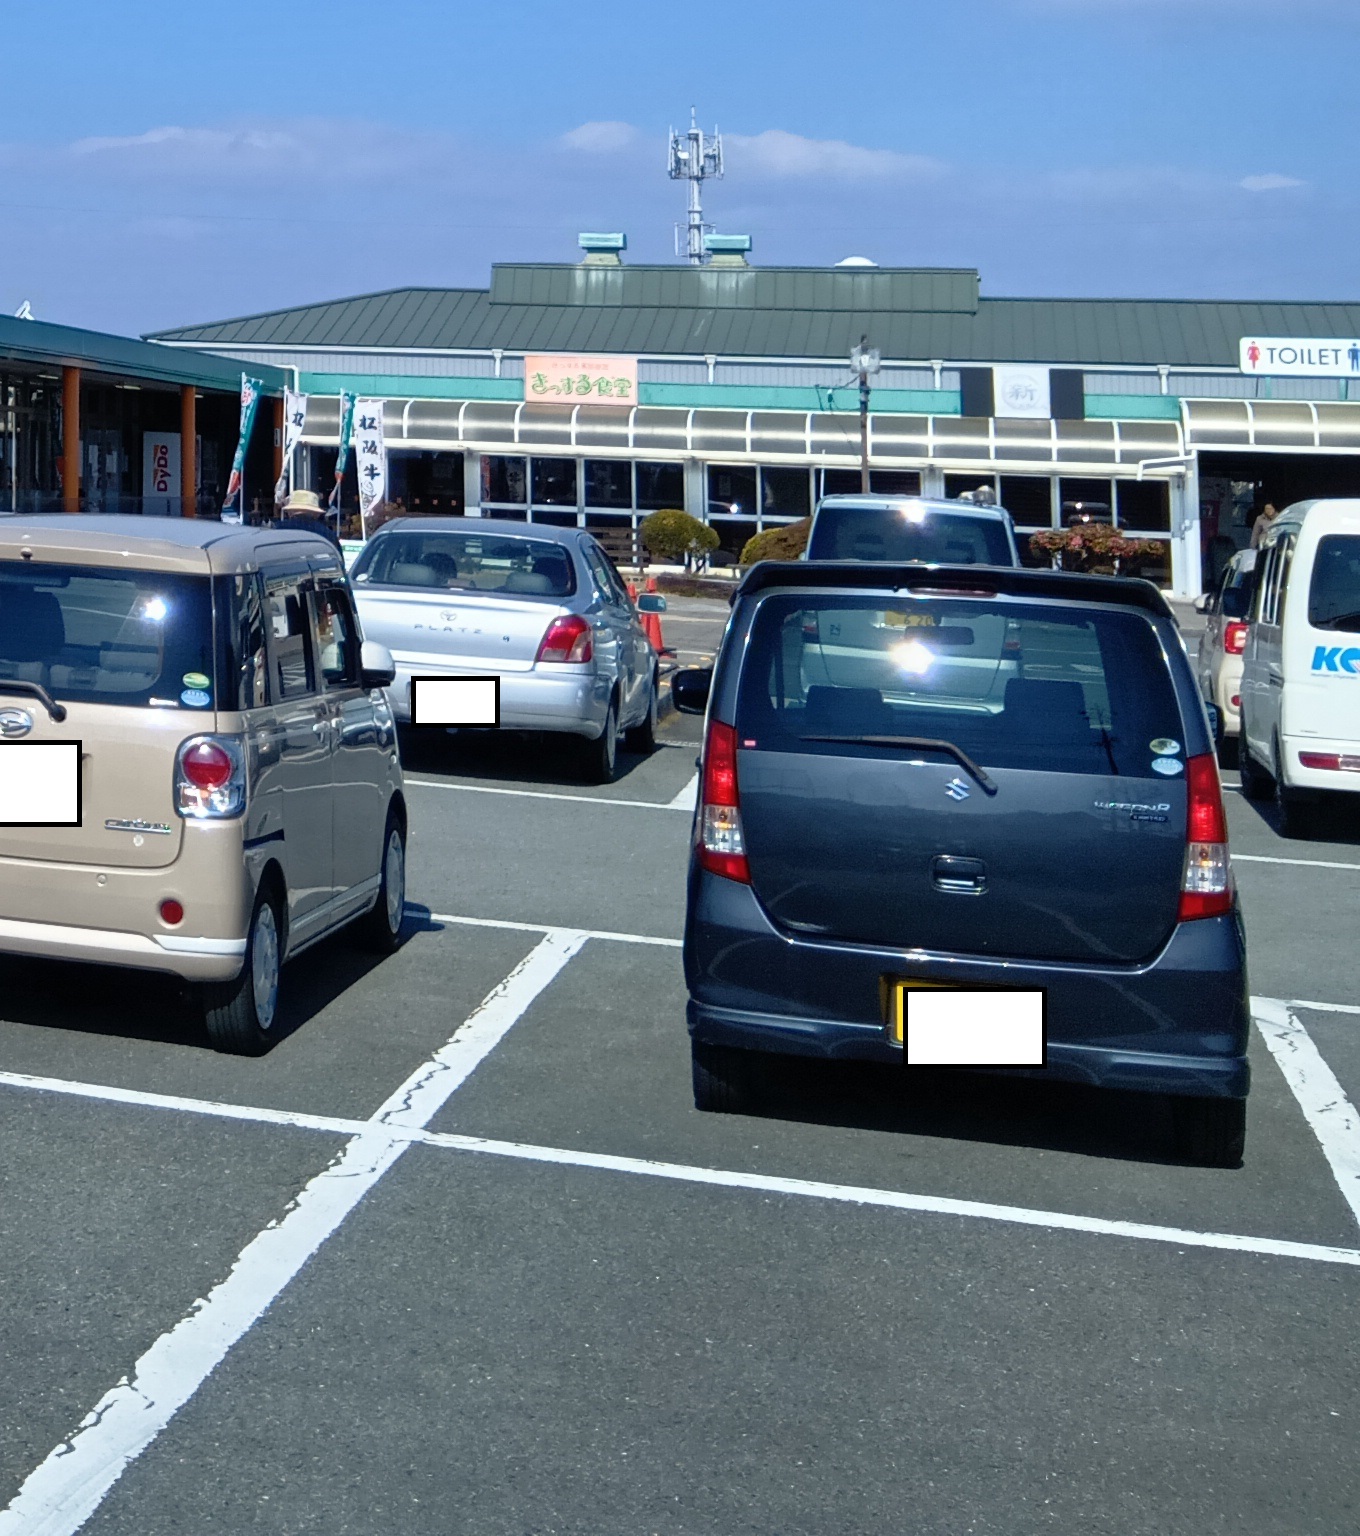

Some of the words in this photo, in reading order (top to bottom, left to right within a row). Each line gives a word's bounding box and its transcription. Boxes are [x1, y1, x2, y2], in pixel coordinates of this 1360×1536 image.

[1266, 347, 1342, 365] TOILET
[530, 372, 632, 398] きっする食堂
[358, 414, 381, 481] 松阪牛
[157, 444, 172, 492] DyDo
